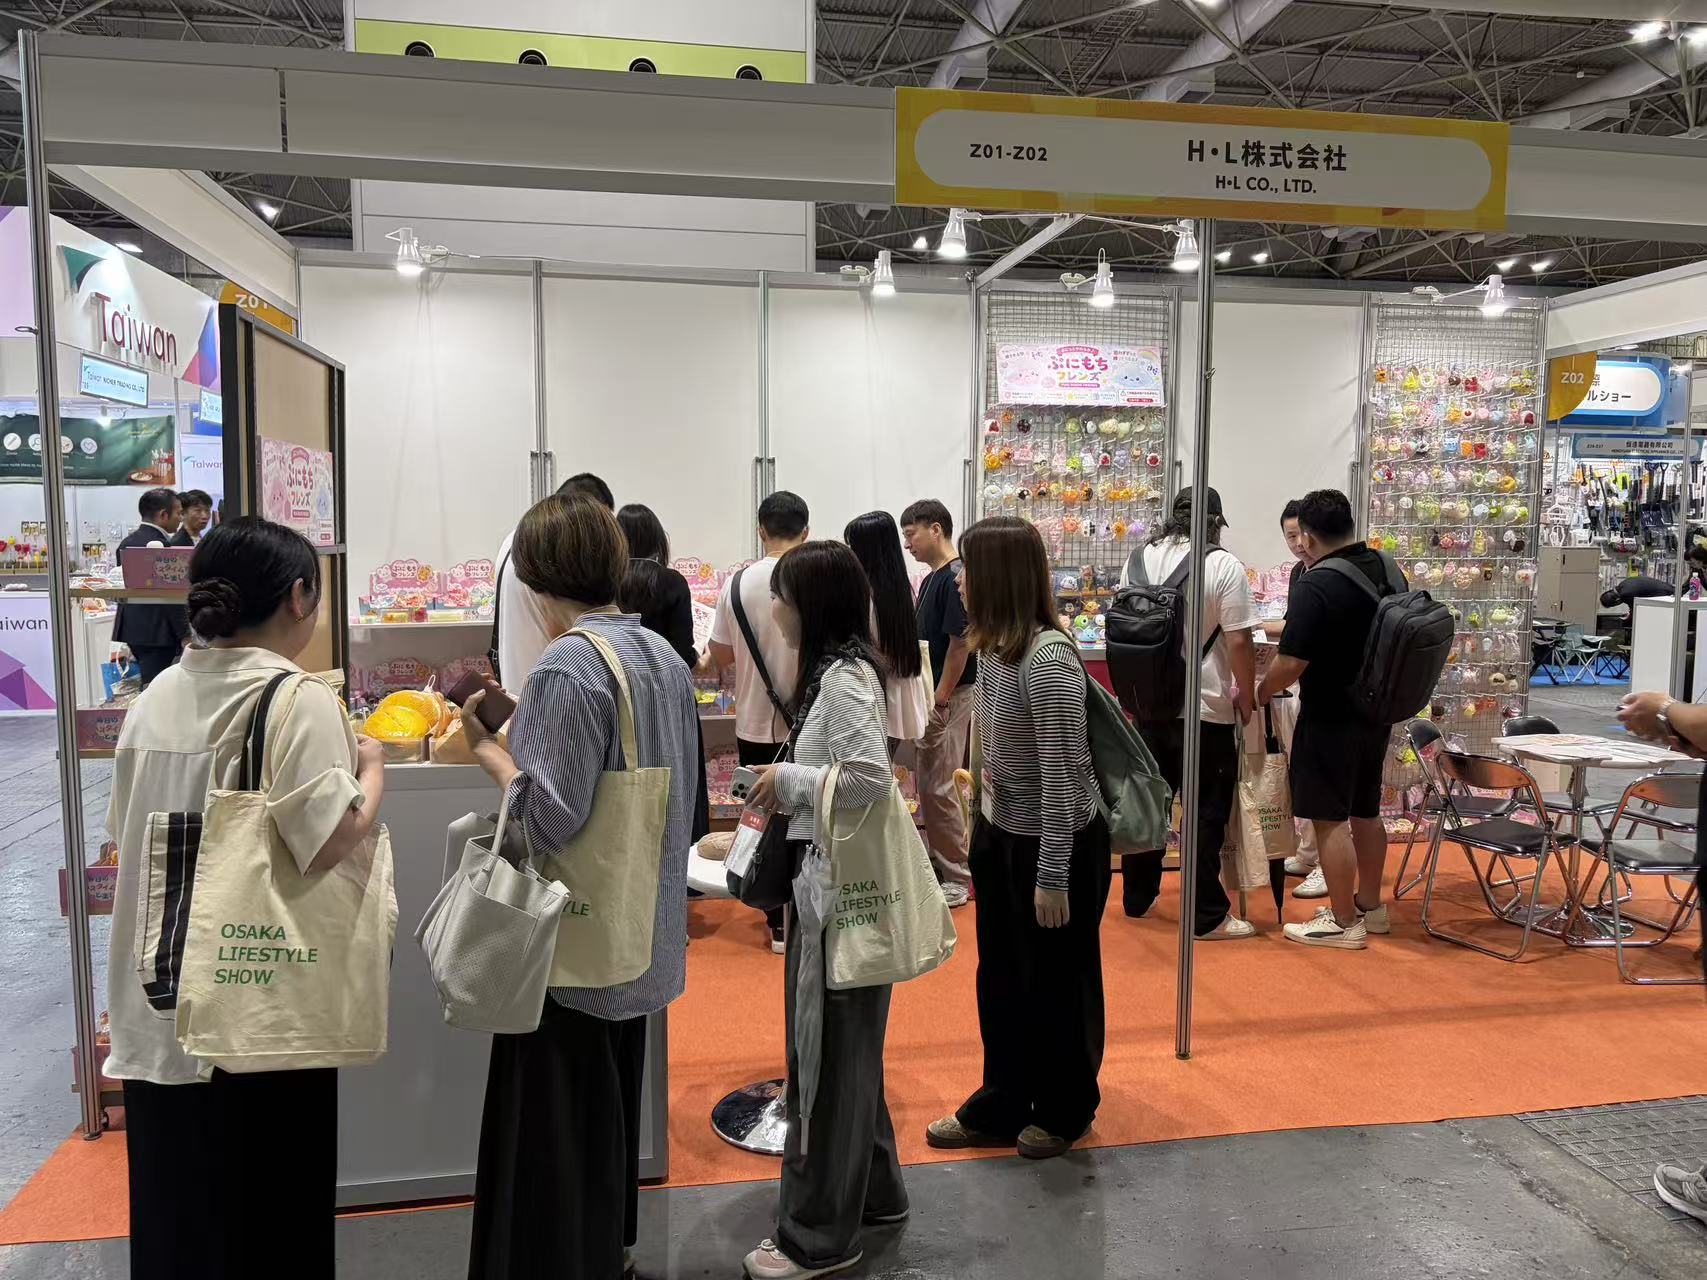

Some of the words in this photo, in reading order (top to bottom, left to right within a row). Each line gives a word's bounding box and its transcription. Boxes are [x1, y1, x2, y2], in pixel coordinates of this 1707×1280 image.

[969, 143, 1048, 162] Z01-Z02
[1246, 176, 1278, 193] CO.,
[1284, 178, 1316, 194] LTD.
[95, 291, 178, 366] Taiwan
[1056, 371, 1101, 382] フレンズ
[1560, 372, 1585, 384] Z02
[839, 880, 879, 896] SAKA
[835, 890, 901, 914] LIFESTYLE
[836, 912, 878, 930] SHOW
[221, 923, 286, 940] OSAKA
[218, 946, 318, 962] LIFESTYLE
[214, 968, 274, 984] SHOW
